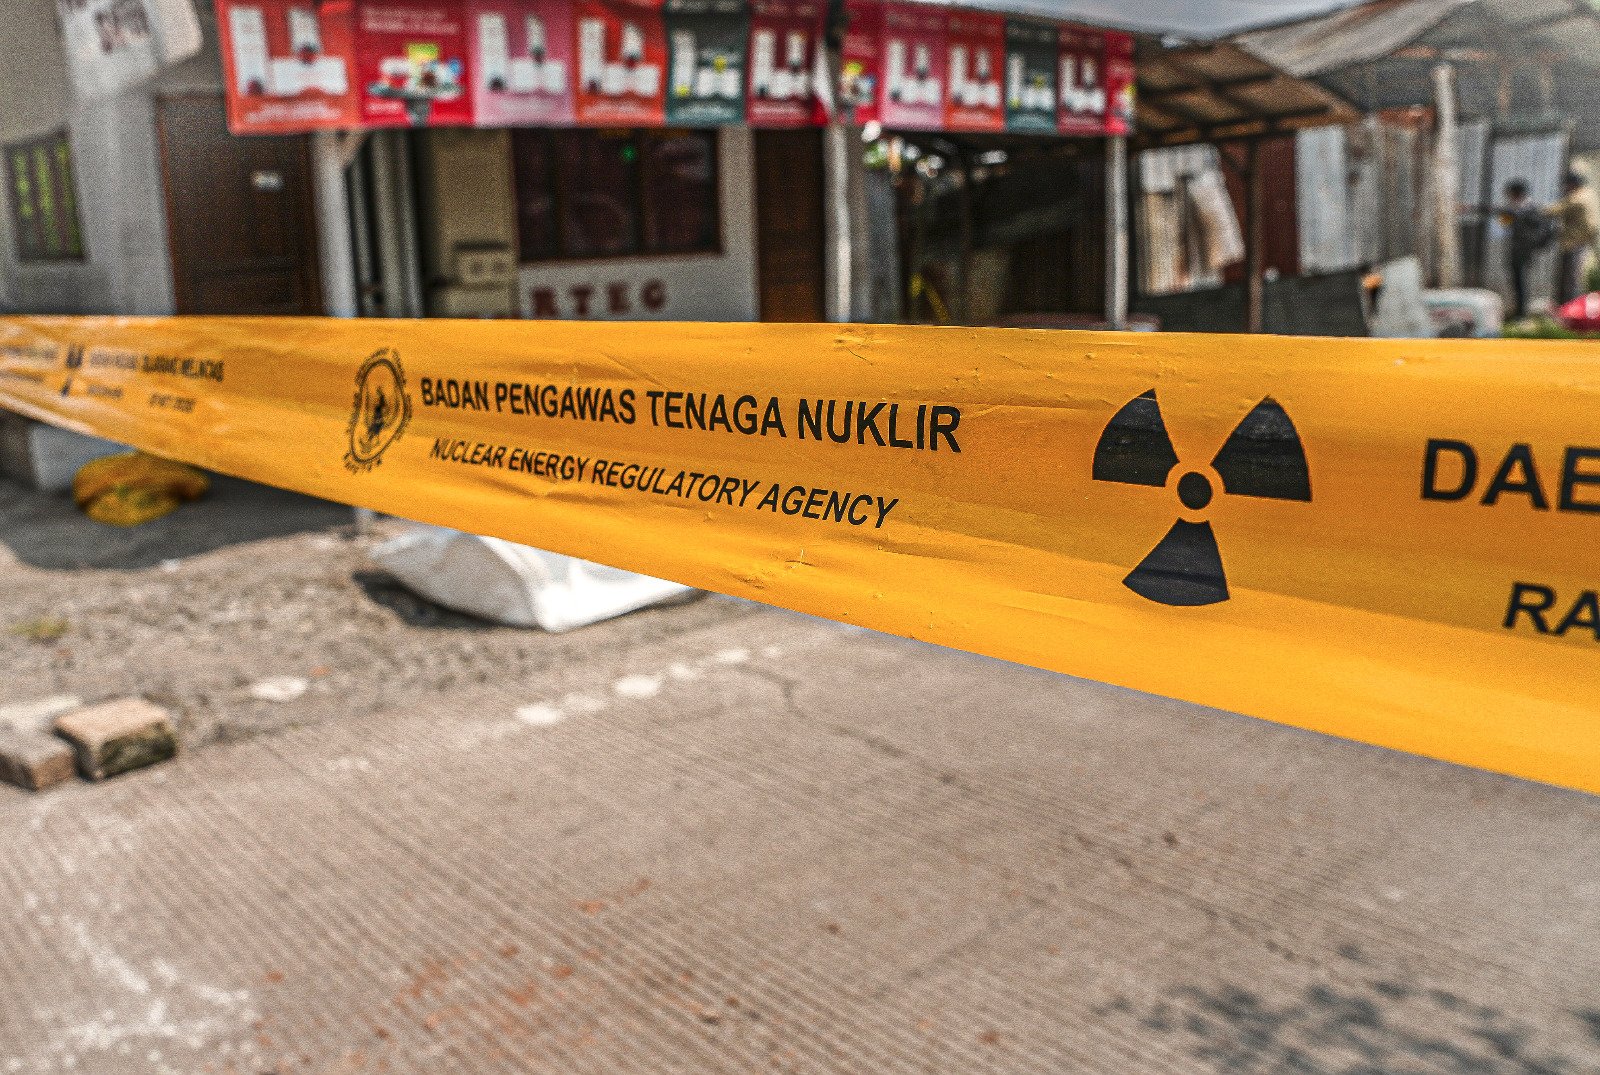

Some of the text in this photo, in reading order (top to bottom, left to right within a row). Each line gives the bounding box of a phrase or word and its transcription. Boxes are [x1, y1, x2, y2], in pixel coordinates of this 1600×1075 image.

[421, 377, 962, 454] BADAN PENGAWAS TENAGA NUKLIR
[430, 437, 899, 530] NUCLEAR ENERGY REGULATORY AGENCY
[1421, 437, 1600, 516] DAE
[1503, 581, 1600, 644] RA
